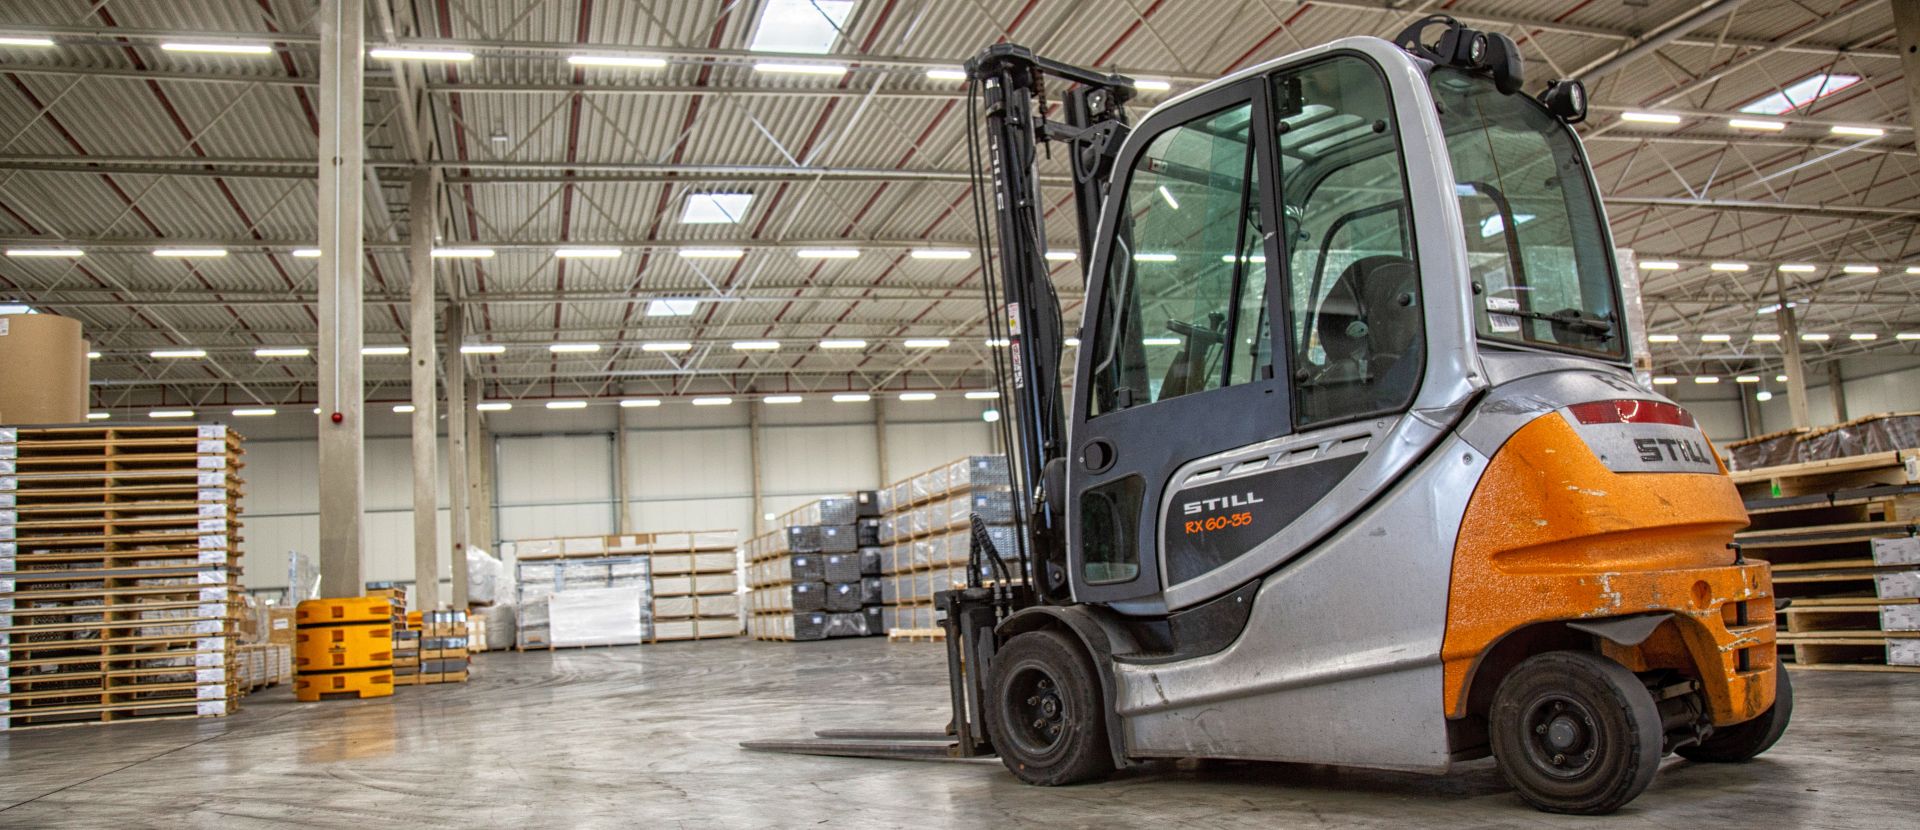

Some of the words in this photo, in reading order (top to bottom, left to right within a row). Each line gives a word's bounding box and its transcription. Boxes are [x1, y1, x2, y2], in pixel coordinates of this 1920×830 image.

[992, 135, 1004, 210] STILL
[1634, 438, 1711, 465] STILL
[1183, 492, 1264, 515] STILL
[1185, 520, 1204, 534] RX
[1205, 512, 1252, 531] 60-35
